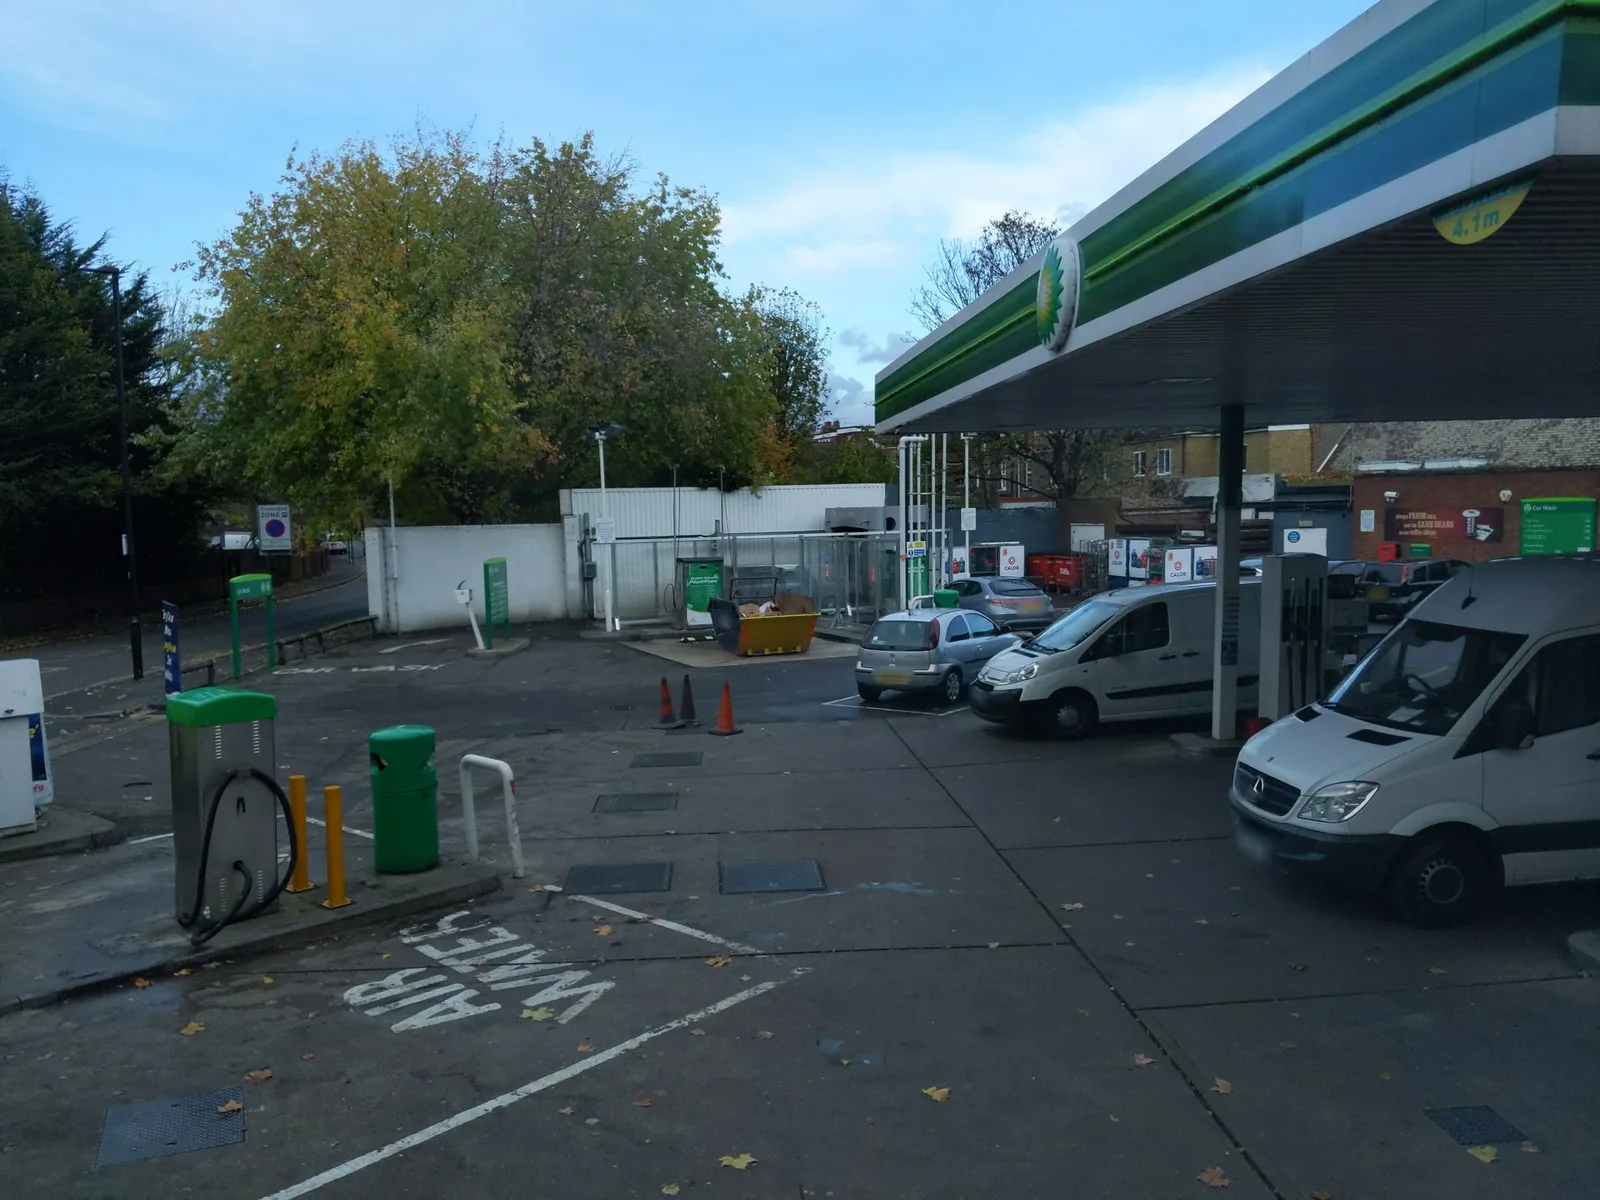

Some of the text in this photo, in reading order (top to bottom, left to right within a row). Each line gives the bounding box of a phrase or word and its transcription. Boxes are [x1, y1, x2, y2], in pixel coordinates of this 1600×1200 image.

[1453, 209, 1499, 238] 4.1m
[1417, 520, 1433, 528] SAME
[1435, 520, 1454, 528] BEANS
[272, 663, 445, 675] CAR WASH
[343, 967, 503, 1034] AIR
